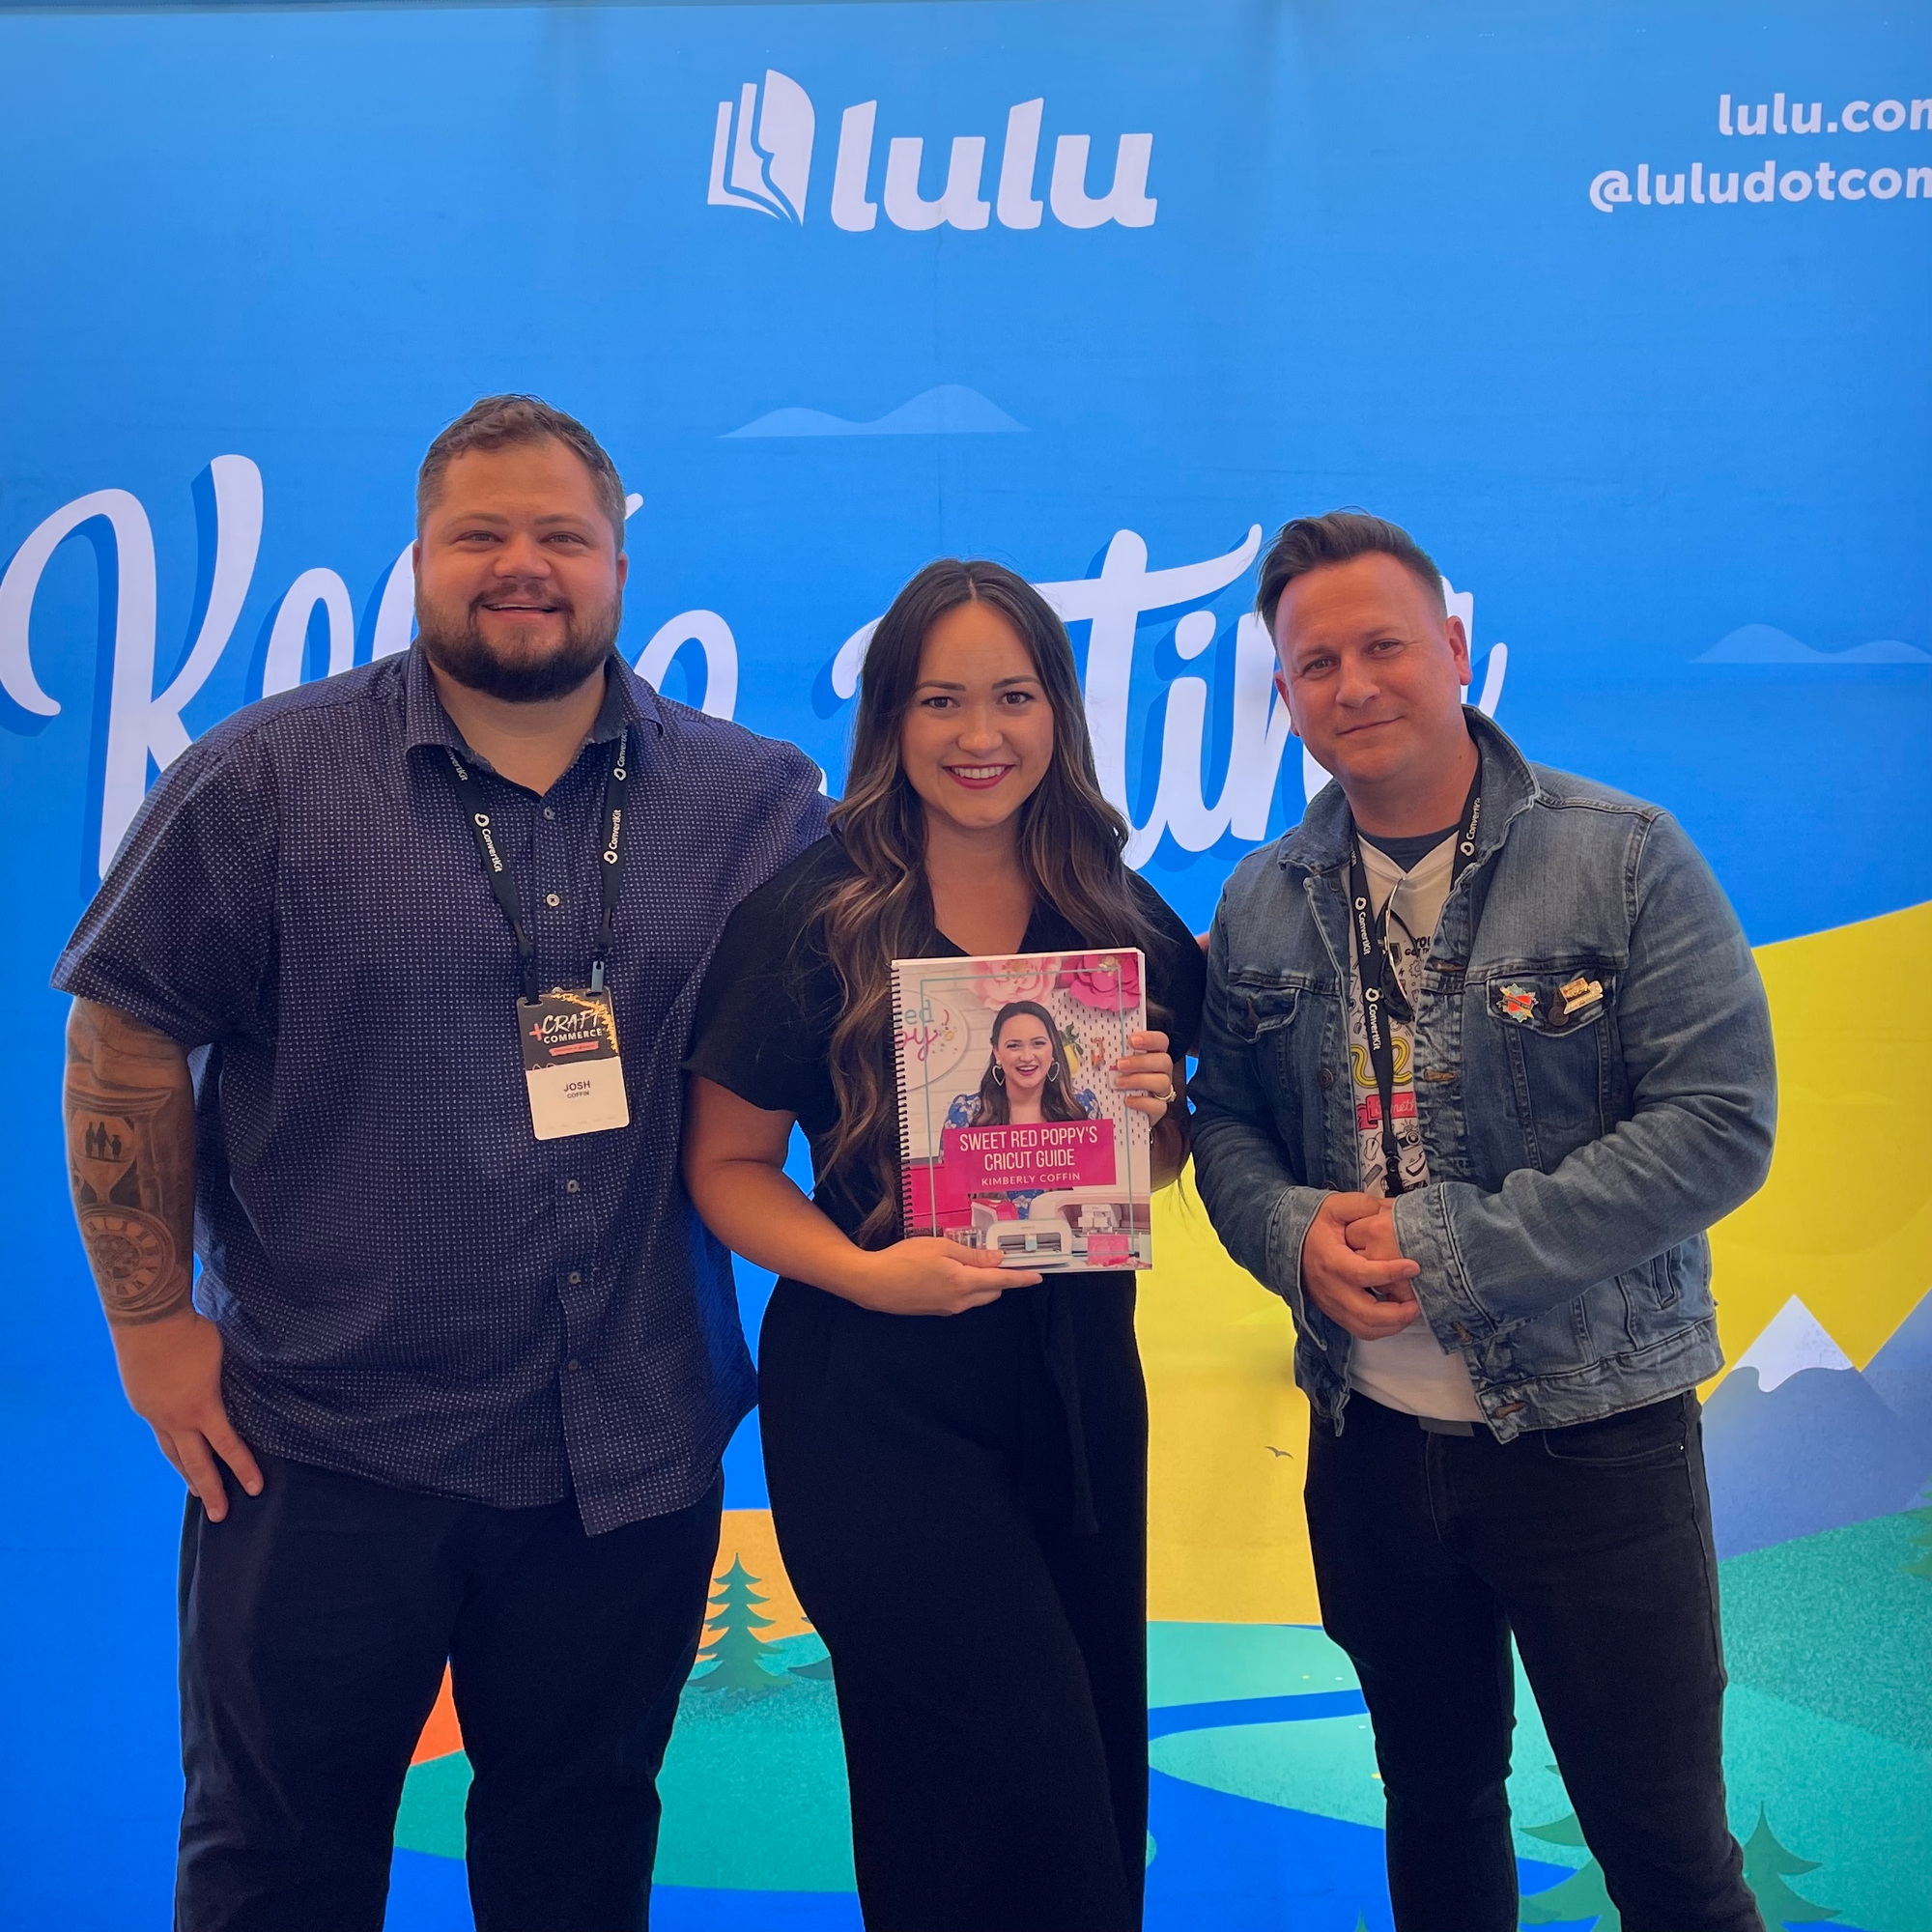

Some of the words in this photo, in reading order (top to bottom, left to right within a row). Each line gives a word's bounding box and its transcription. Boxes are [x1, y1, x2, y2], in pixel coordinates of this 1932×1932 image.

[831, 98, 1157, 232] lulu
[608, 809, 622, 850] ConvertKit
[482, 828, 503, 873] ConvertKit
[1357, 911, 1372, 955] ConvertKit
[542, 1009, 600, 1035] CRAFT
[1367, 1003, 1380, 1051] ConvertKit
[543, 1028, 603, 1044] COMMERCE
[563, 1080, 591, 1093] JOSH
[566, 1091, 590, 1099] COFFIN
[959, 1131, 1008, 1151] SWEET
[1010, 1129, 1038, 1149] RED
[1041, 1125, 1098, 1147] POPPY'S
[984, 1151, 1033, 1172] CRICUT
[1036, 1149, 1075, 1168] GUIDE
[981, 1175, 1036, 1186] KIMBERLY
[1039, 1172, 1080, 1183] COFFIN
